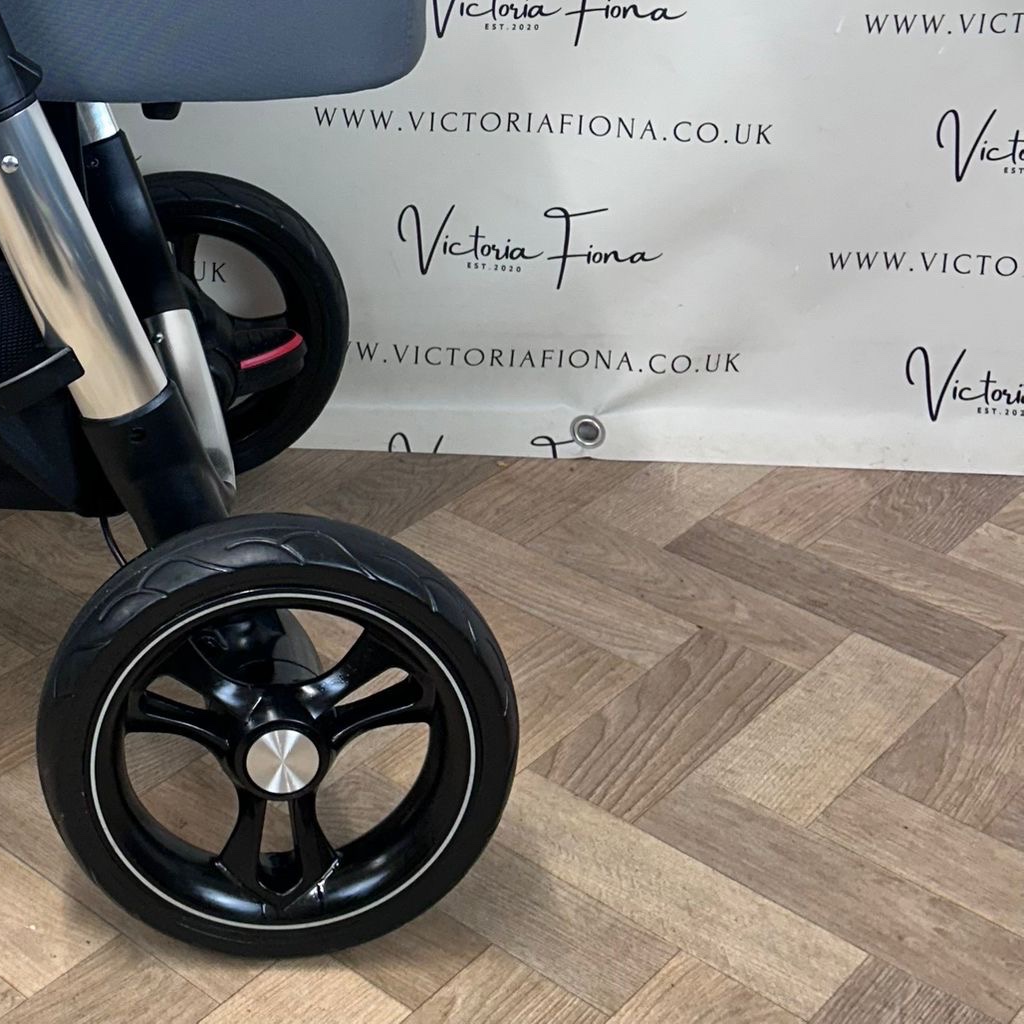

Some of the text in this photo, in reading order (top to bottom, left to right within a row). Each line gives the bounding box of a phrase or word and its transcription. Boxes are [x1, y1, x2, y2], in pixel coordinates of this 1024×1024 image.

[484, 23, 540, 31] EST.2020
[314, 106, 774, 145] WWW.VICTORIAFIONA.CO.UK
[397, 204, 663, 290] Victoria Fiona
[467, 262, 522, 272] EST.2020
[829, 251, 1024, 277] WWW.VICTO
